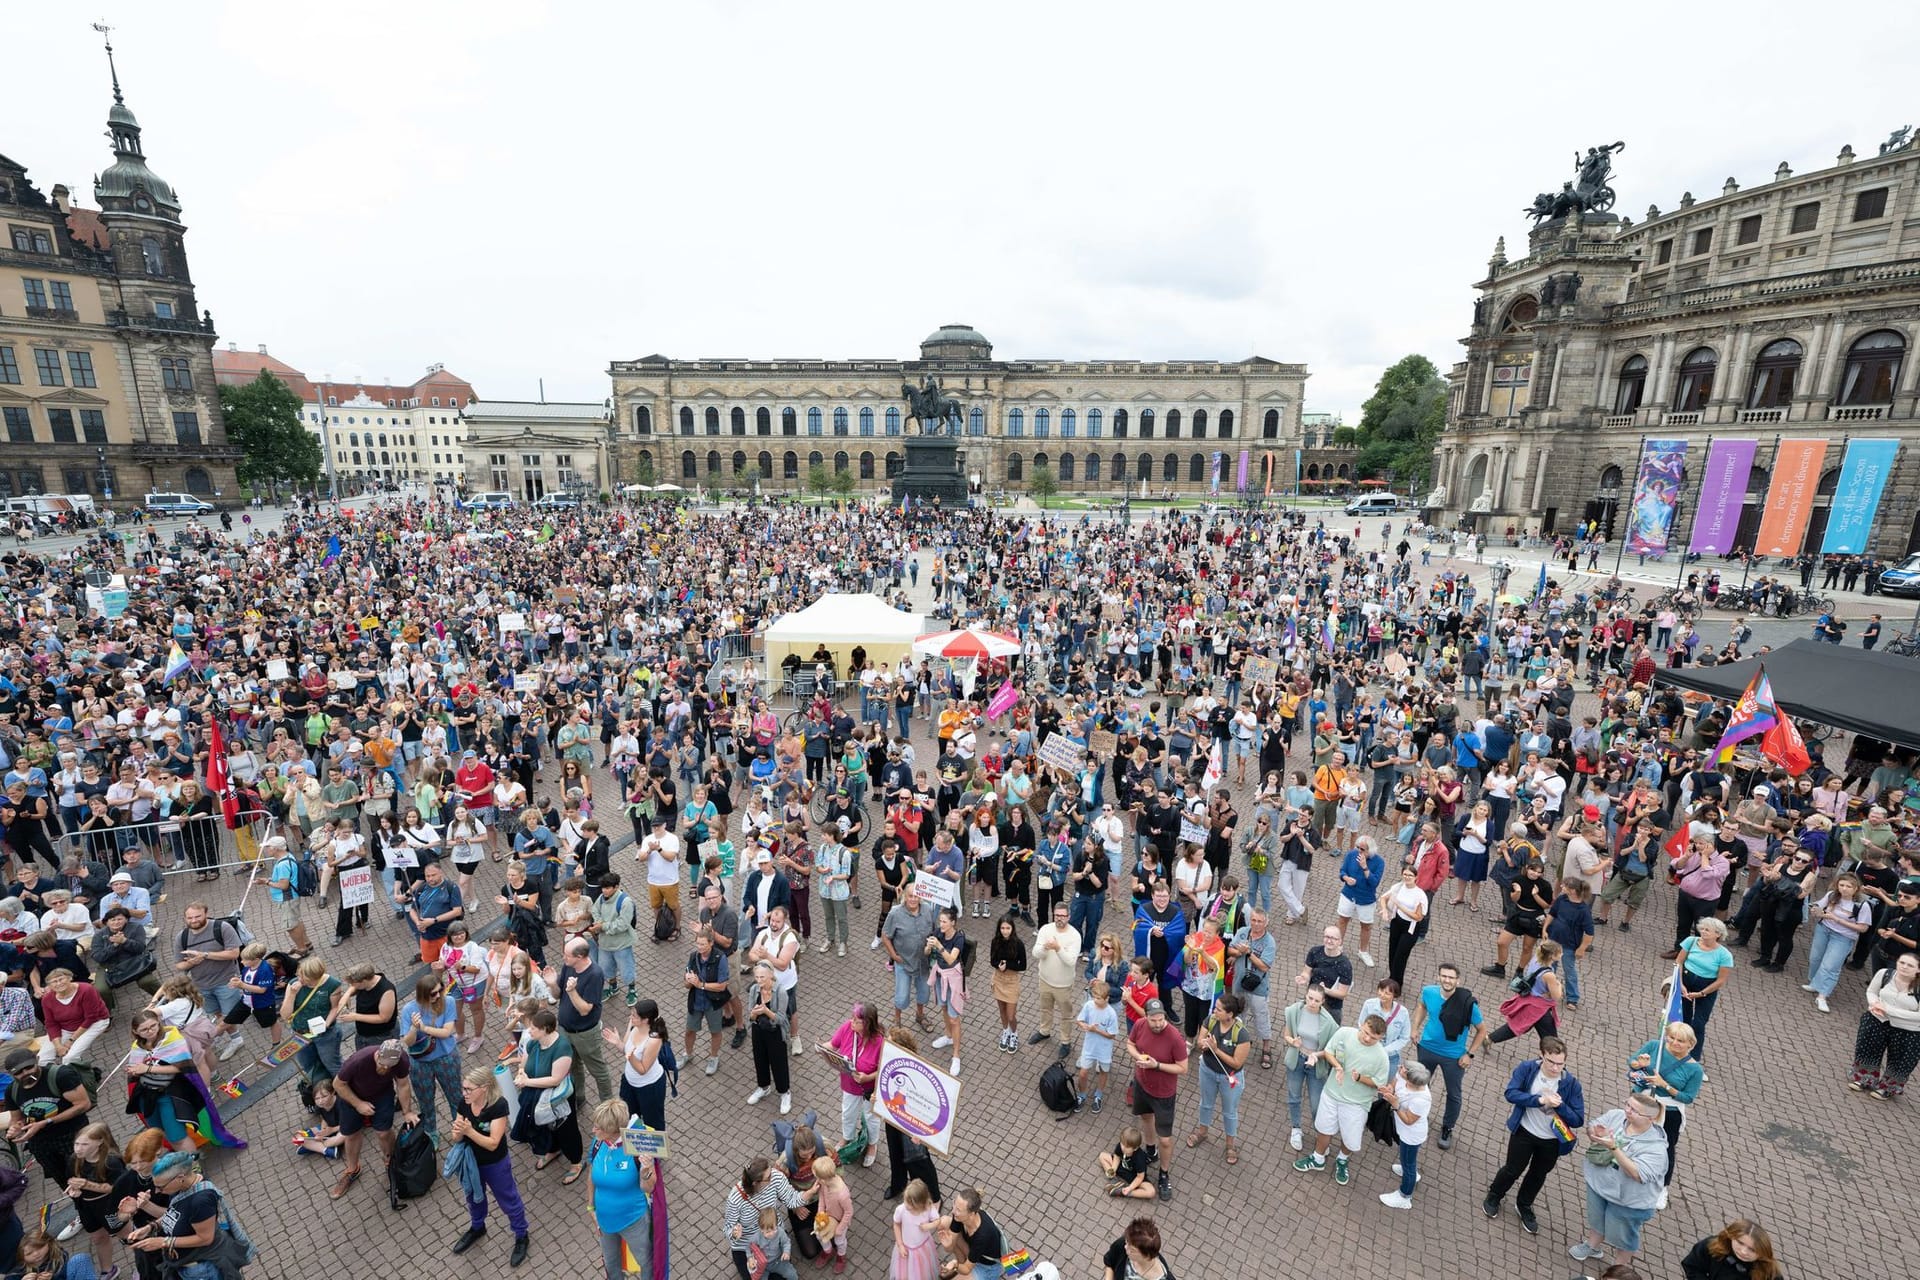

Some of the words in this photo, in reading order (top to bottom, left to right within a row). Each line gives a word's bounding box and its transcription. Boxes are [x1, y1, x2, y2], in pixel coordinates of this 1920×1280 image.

[1723, 453, 1738, 490] summer!
[1798, 447, 1815, 482] diversity
[1849, 458, 1867, 488] Season
[1863, 465, 1879, 486] 2024
[1718, 491, 1729, 508] nice
[1793, 481, 1804, 498] and
[1848, 490, 1858, 502] the
[1773, 496, 1786, 510] For
[1855, 487, 1872, 515] August
[1708, 514, 1724, 536] Have
[1779, 499, 1801, 544] democracy
[1836, 513, 1851, 533] Start
[1851, 514, 1863, 526] 29
